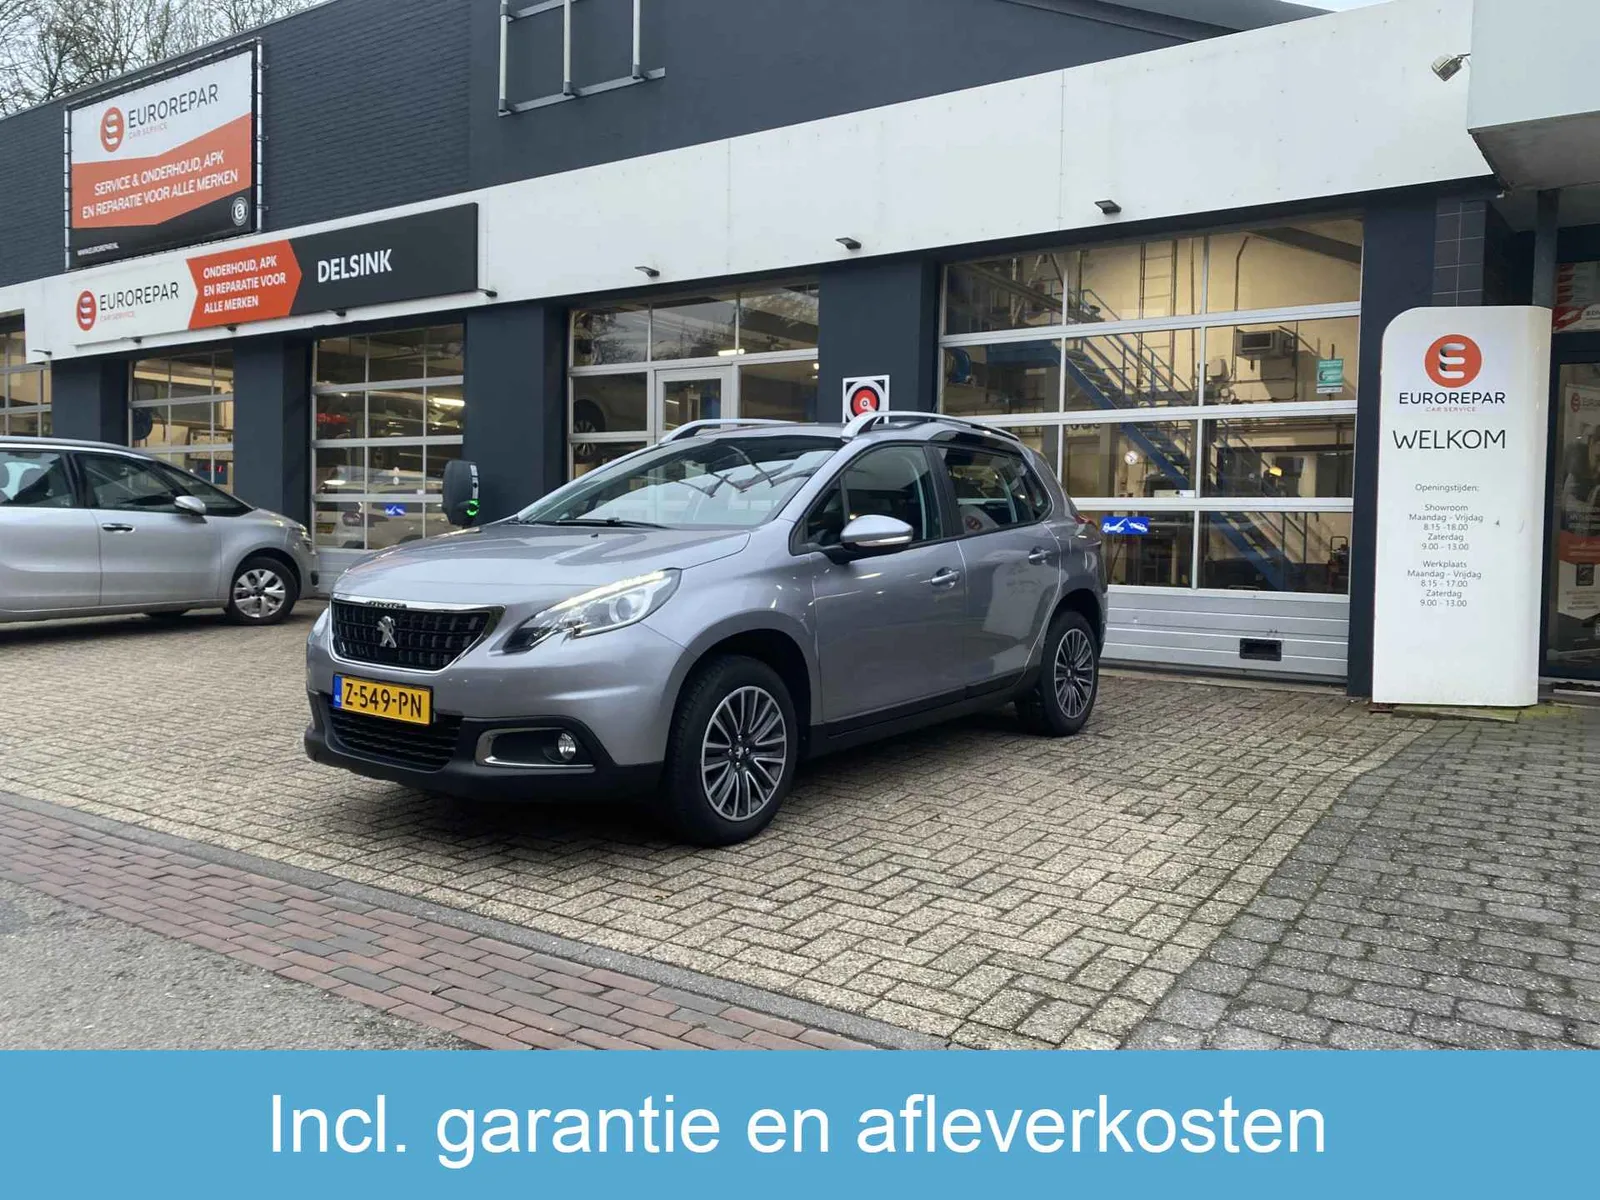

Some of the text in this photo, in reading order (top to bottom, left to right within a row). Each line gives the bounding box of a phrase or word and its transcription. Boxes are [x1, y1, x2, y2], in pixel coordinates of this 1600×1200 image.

[128, 84, 218, 128] EUROREPAR
[94, 150, 224, 196] SERVICE & ONDERHOUD, APK
[82, 169, 238, 219] EN REPARATIE VOOR ALLE MERKEN
[204, 255, 277, 279] ONDERHOUD, APK
[317, 248, 392, 283] DELSINK
[204, 272, 286, 296] EN REPARATIE VOOR
[100, 282, 179, 311] EUROREPAR
[204, 296, 259, 314] ALLE MERKEN
[1399, 392, 1506, 404] EUROREPAR
[1393, 430, 1506, 449] WELKOM
[1415, 484, 1480, 493] Openingstijden:
[1409, 514, 1446, 522] Maandag
[1455, 514, 1484, 523] Vrijdag
[1428, 533, 1464, 542] Zaterdag
[1423, 560, 1467, 568] Werkplaats
[1408, 570, 1445, 579] Maandag
[1453, 570, 1482, 579] Vrijdag
[1420, 599, 1437, 607] 9.00
[1426, 590, 1462, 599] Zaterdag
[345, 683, 422, 718] Z-549-PN
